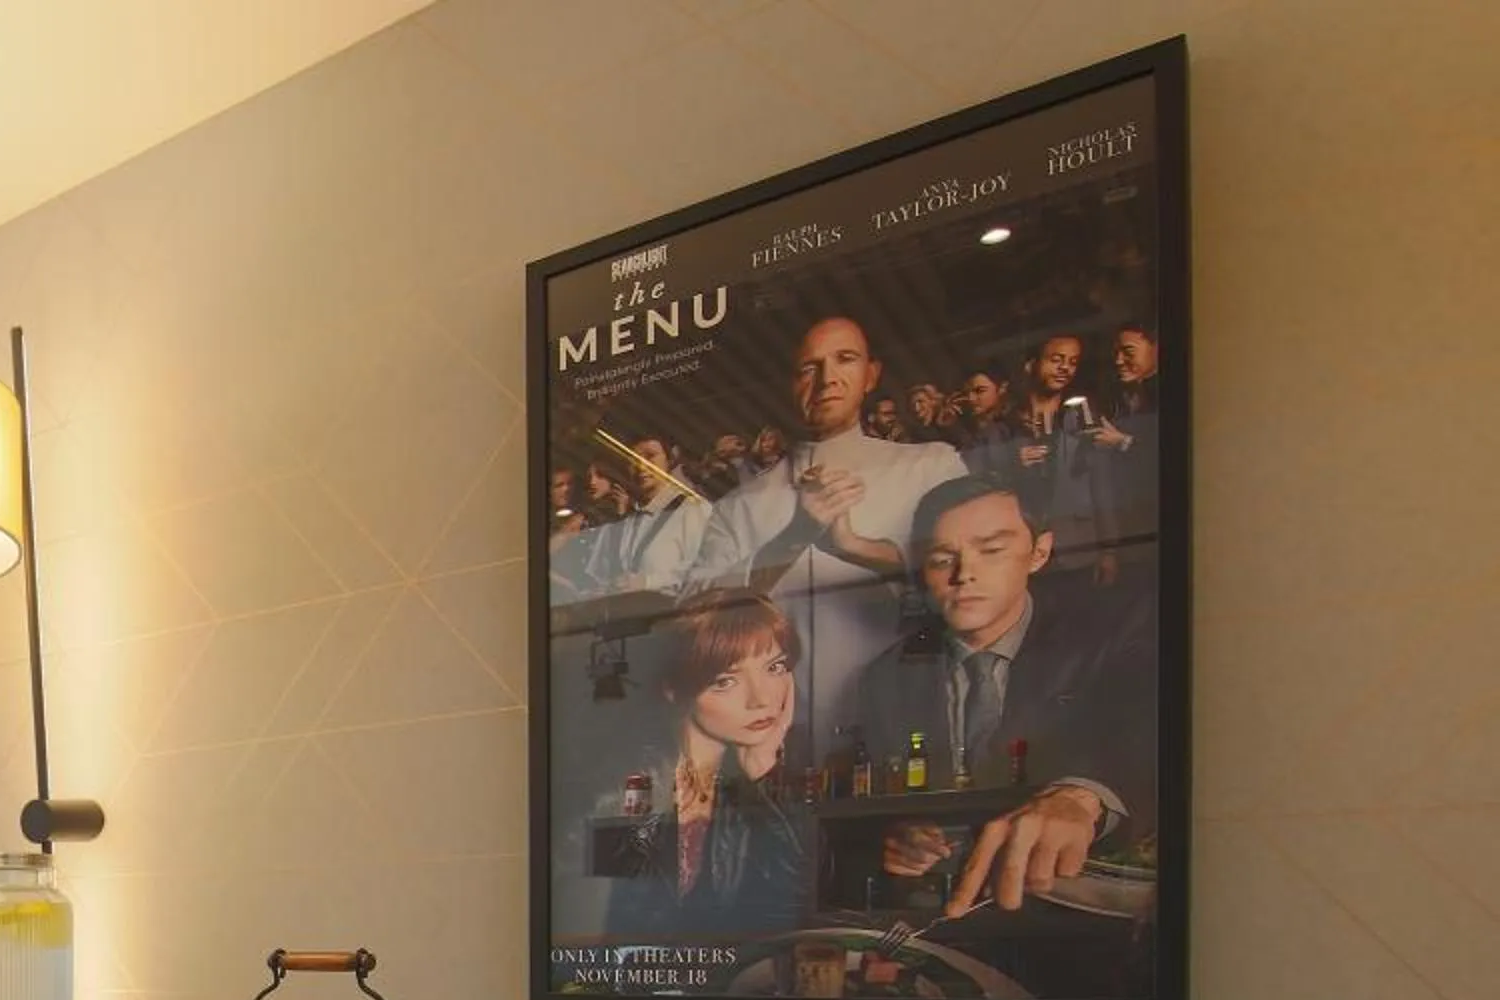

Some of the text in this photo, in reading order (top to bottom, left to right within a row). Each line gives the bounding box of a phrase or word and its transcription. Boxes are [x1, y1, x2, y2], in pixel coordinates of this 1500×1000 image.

[1047, 121, 1138, 160] NICHOLAS
[1048, 133, 1138, 176] HOULT
[871, 168, 1012, 229] TAYLOR-JOY
[921, 179, 960, 198] ANYA
[751, 224, 842, 269] FIENNES
[772, 222, 817, 246] RALPH
[613, 281, 665, 311] the
[559, 285, 729, 372] MENU
[551, 947, 738, 964] ONLY IN THEATERS
[575, 967, 708, 985] NOVEMBER 18
